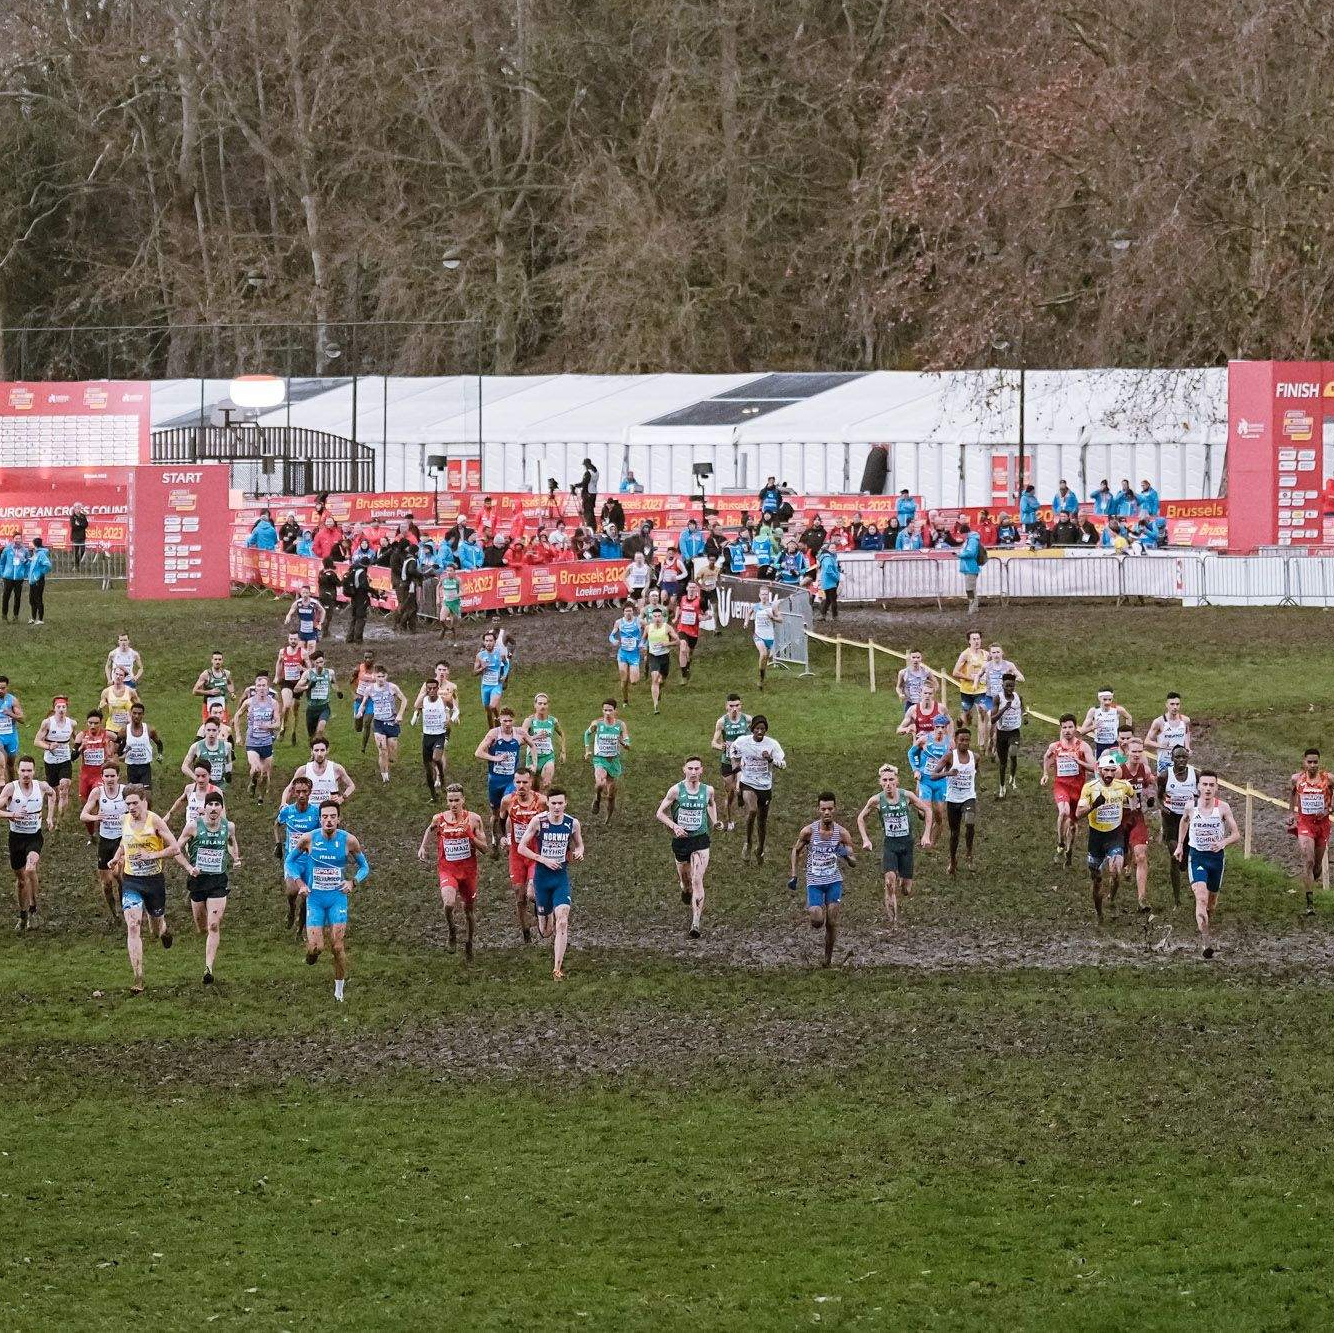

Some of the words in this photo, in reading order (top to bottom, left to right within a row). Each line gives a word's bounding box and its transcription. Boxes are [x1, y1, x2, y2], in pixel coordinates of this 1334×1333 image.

[1276, 382, 1320, 398] FINISH
[161, 472, 203, 484] START
[356, 497, 399, 509] Brussels
[401, 496, 429, 508] 2023
[53, 506, 88, 516] CRS
[1167, 503, 1224, 517] Brussels
[102, 527, 123, 539] 2023
[1199, 523, 1228, 536] Brusse
[560, 566, 605, 585] Brussels
[575, 586, 601, 597] Laeken
[602, 585, 619, 596] Park
[679, 815, 701, 824] DALTON
[543, 832, 570, 841] NORWAY
[542, 847, 566, 855] MYHRE
